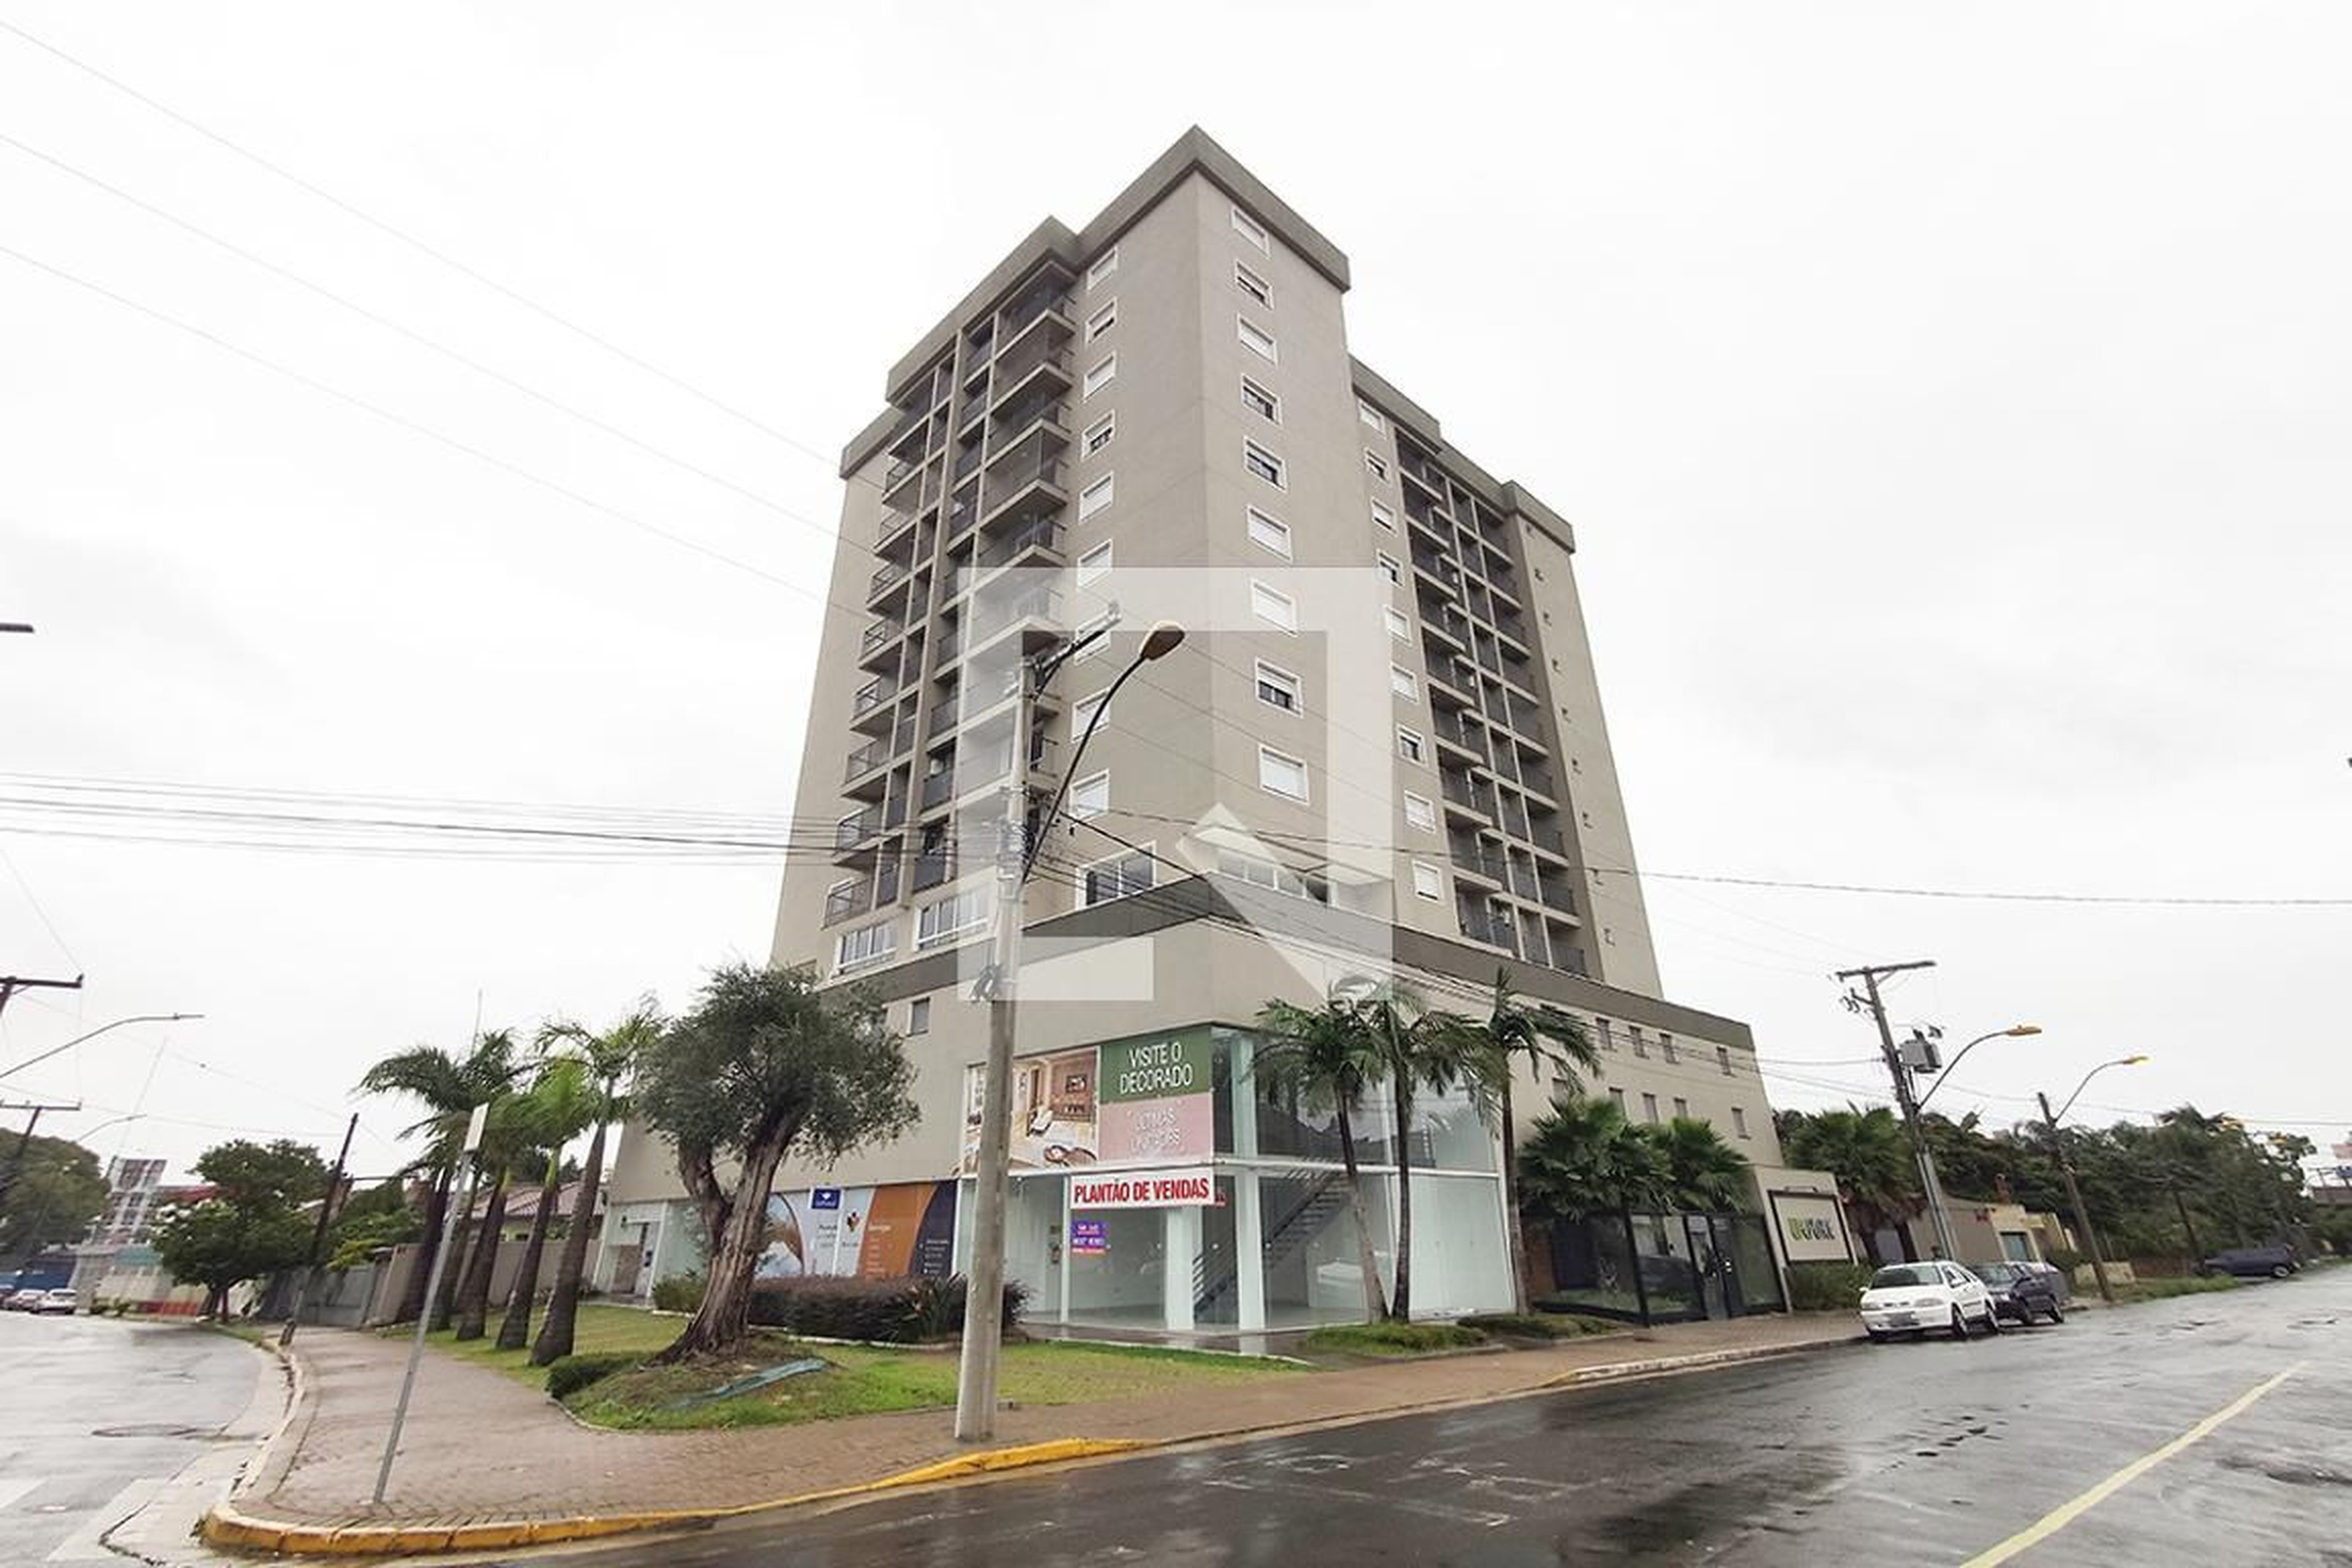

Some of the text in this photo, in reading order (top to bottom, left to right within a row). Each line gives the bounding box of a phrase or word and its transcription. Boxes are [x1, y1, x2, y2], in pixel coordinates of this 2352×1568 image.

[1128, 1041, 1182, 1068] VISITE O
[1120, 1064, 1194, 1094] DECORADO
[1074, 1178, 1131, 1203] PLANTÃO
[1133, 1180, 1151, 1202] DE
[1153, 1177, 1210, 1200] VENDAS
